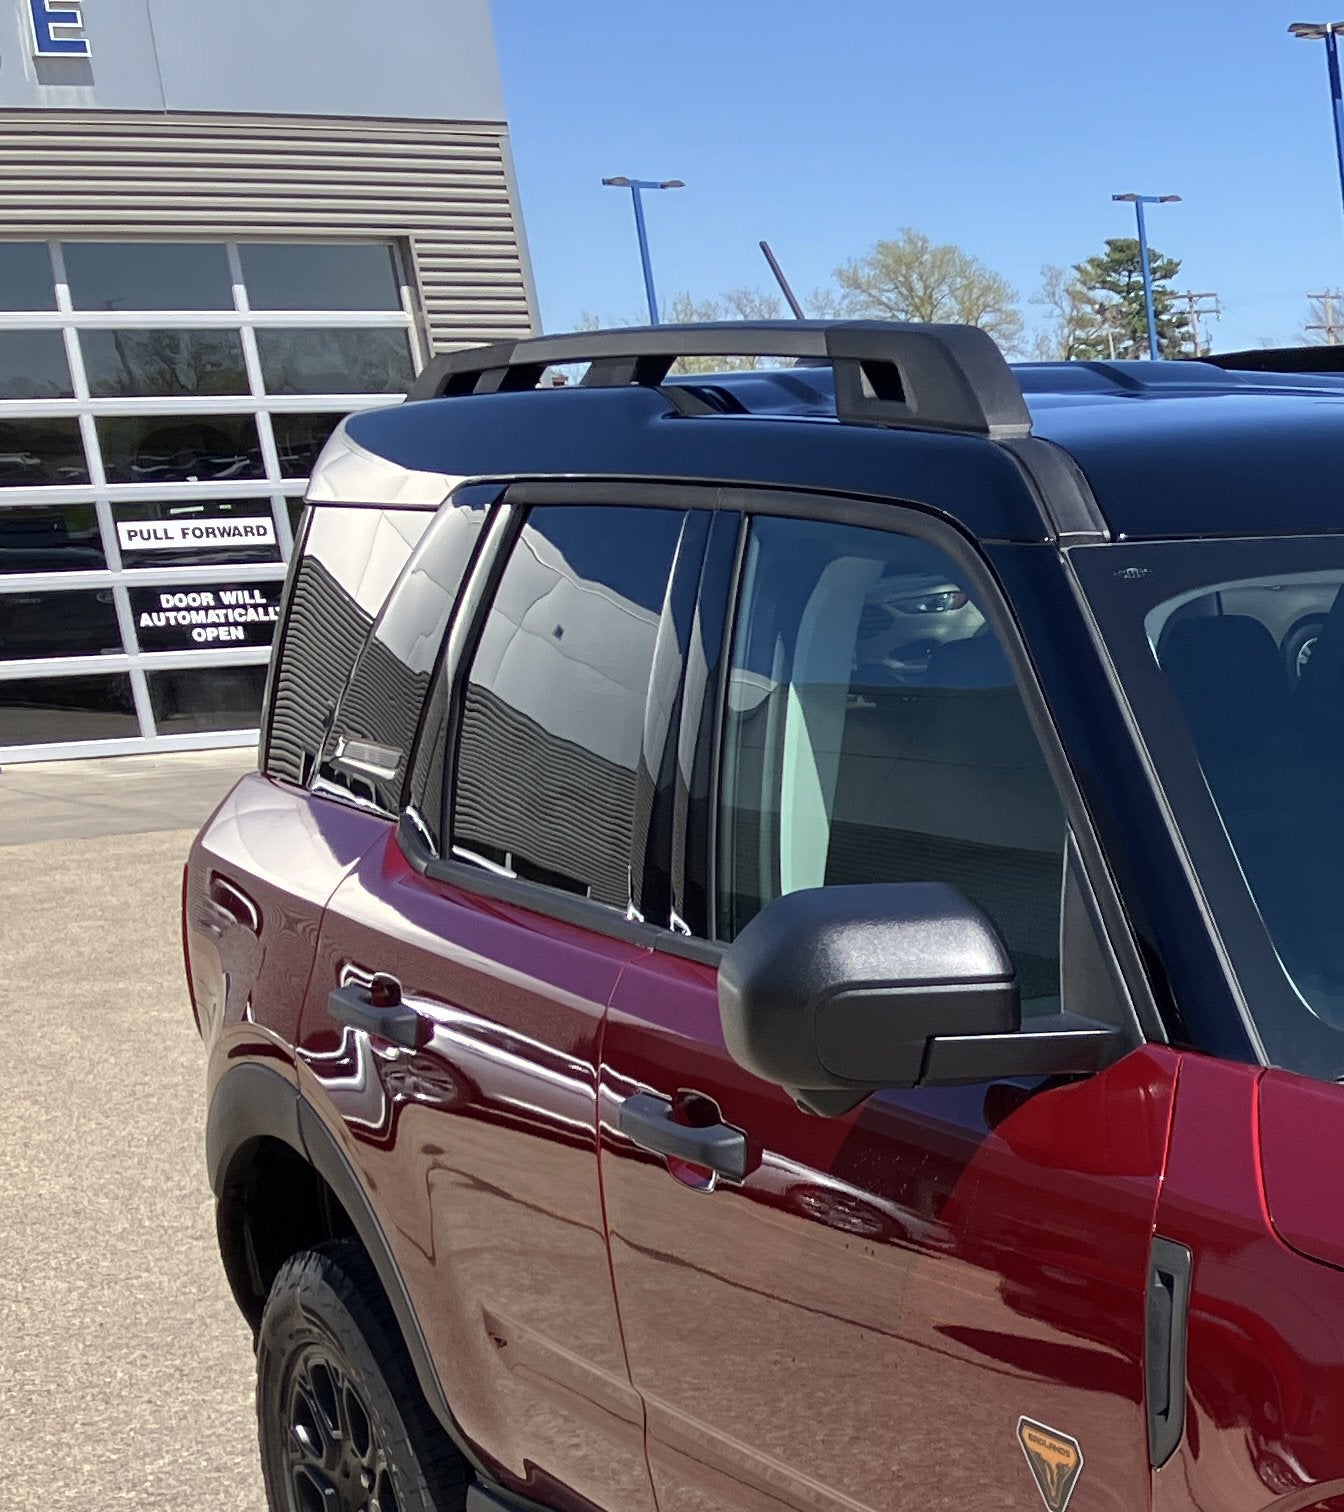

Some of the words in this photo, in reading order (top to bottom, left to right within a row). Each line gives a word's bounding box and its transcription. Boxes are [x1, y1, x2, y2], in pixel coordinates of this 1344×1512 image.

[127, 528, 174, 542] PULL
[181, 525, 268, 539] FORWARD
[159, 592, 215, 609] DOOR
[219, 589, 267, 605] WILL
[139, 606, 280, 628] AUTOMATICALL
[191, 626, 245, 642] OPEN
